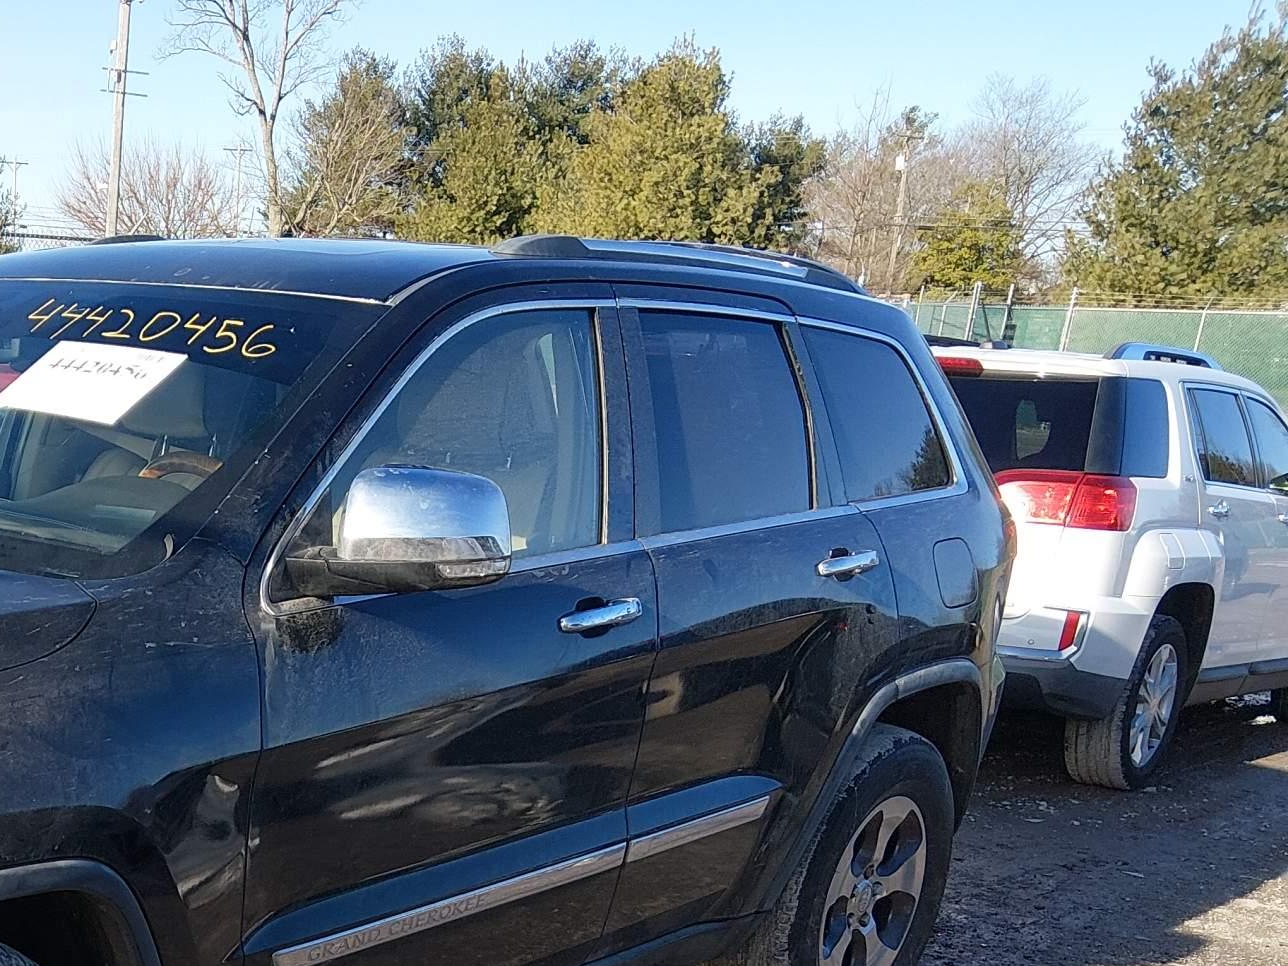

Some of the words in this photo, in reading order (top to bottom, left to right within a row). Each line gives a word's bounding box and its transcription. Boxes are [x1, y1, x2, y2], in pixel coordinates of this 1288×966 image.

[28, 298, 276, 358] 44420456
[306, 928, 381, 962] GRAND
[390, 893, 487, 936] CHEROKEE
